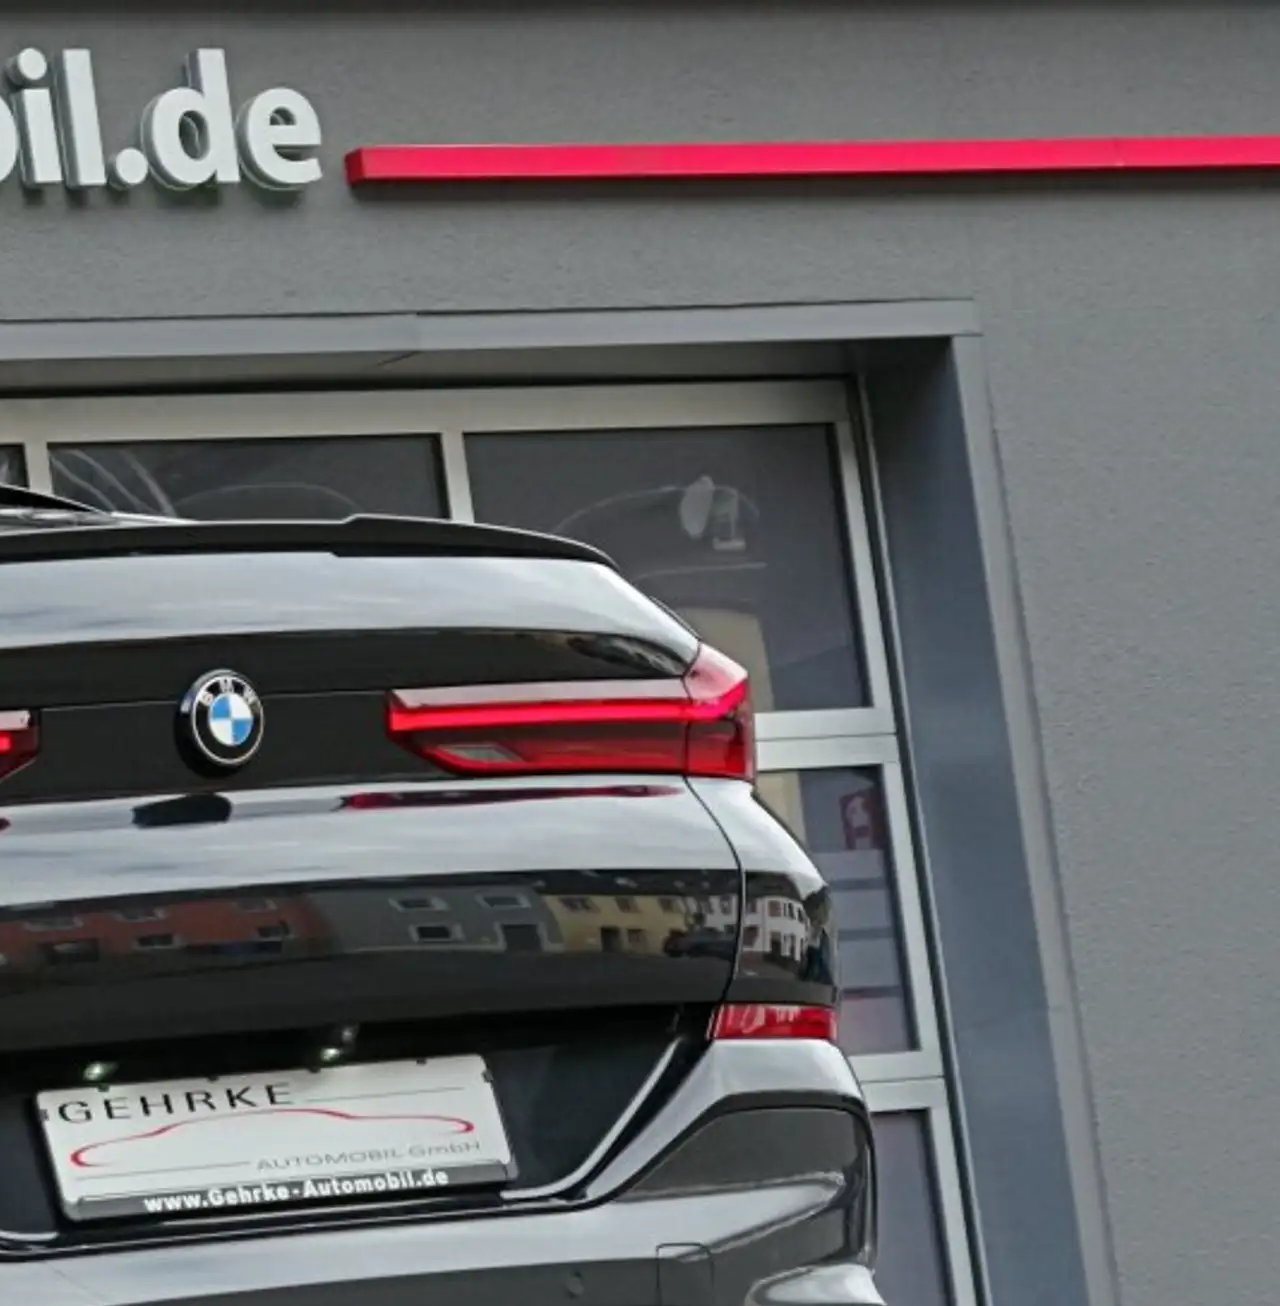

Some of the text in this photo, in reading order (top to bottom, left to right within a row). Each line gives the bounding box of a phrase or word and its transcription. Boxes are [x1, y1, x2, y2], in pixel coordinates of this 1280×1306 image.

[58, 1082, 296, 1125] GEHRKE
[255, 1139, 481, 1172] AUTOMOBIL GmbH
